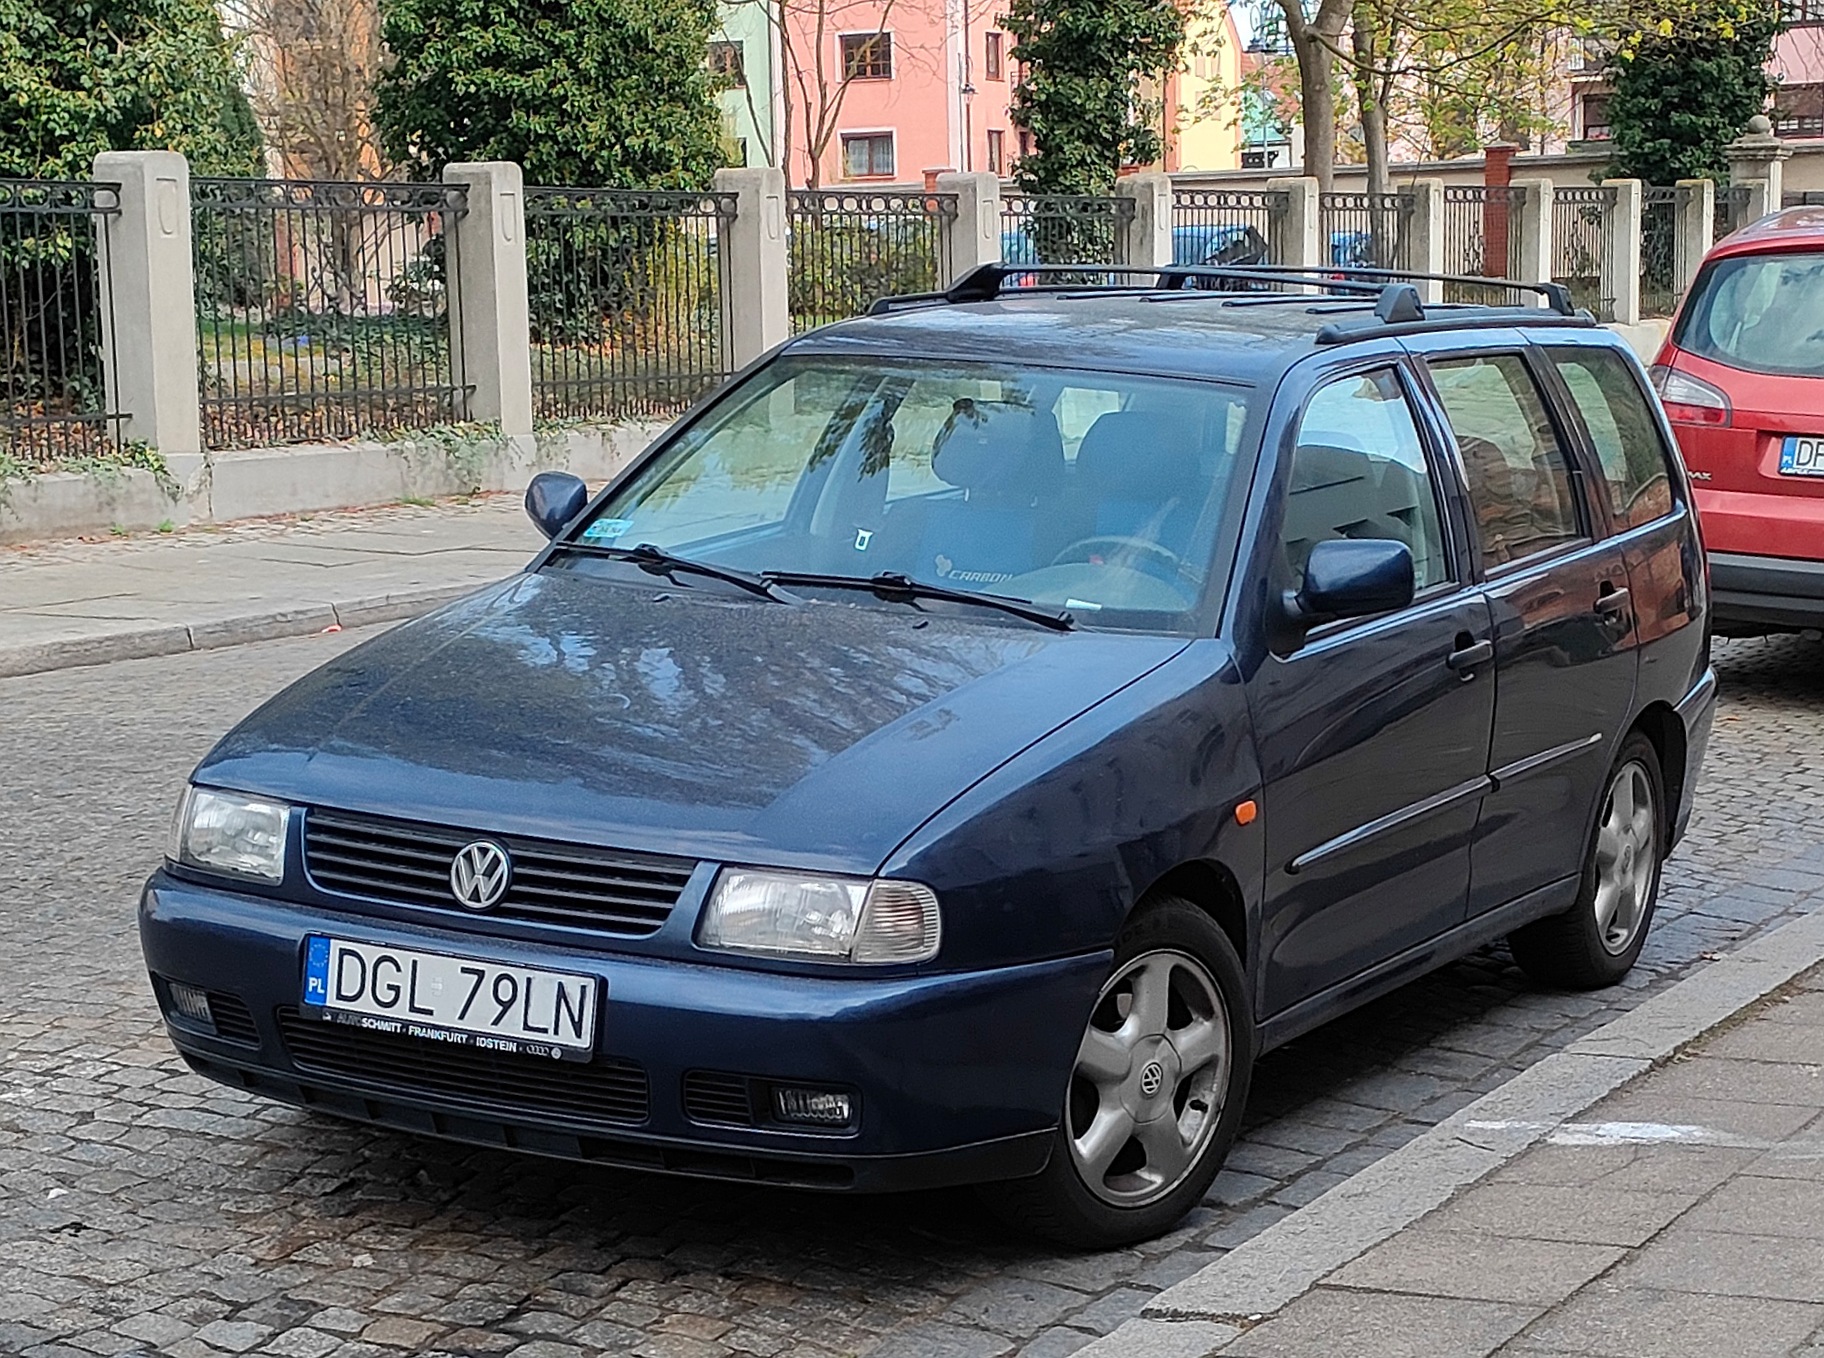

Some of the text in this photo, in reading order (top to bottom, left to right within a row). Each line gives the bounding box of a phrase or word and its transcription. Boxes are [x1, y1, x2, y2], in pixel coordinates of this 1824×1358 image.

[948, 570, 1013, 583] CARBON
[308, 976, 325, 994] PL
[335, 947, 587, 1040] DGL 79LN
[408, 1025, 468, 1045] FRANKFURT
[476, 1036, 517, 1053] IDSTEIN
